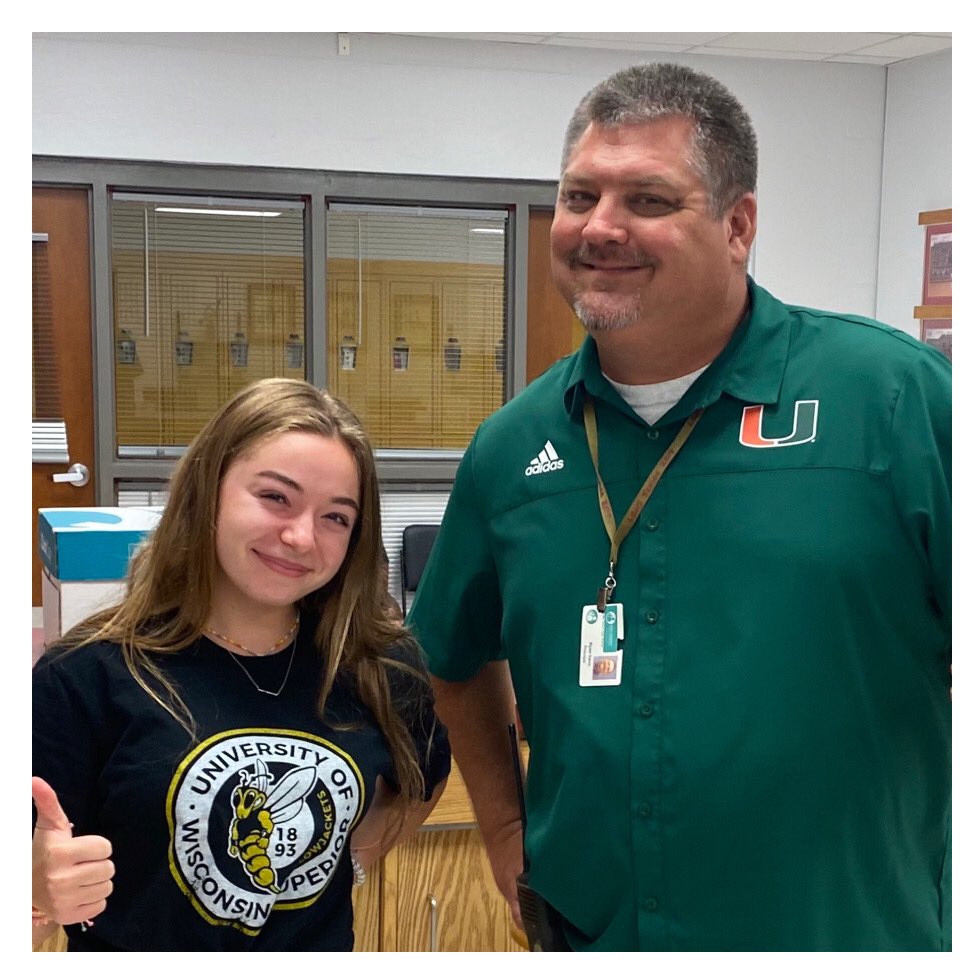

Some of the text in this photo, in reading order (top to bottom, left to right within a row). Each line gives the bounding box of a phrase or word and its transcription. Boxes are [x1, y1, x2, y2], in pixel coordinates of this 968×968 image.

[739, 400, 819, 448] U
[525, 458, 564, 476] adidas
[191, 742, 354, 801] UNIVERSITY OF
[276, 828, 297, 841] 18
[302, 790, 333, 861] OWJACKETS
[182, 818, 350, 920] WISCONSIN UPERIOR
[275, 843, 296, 857] 93
